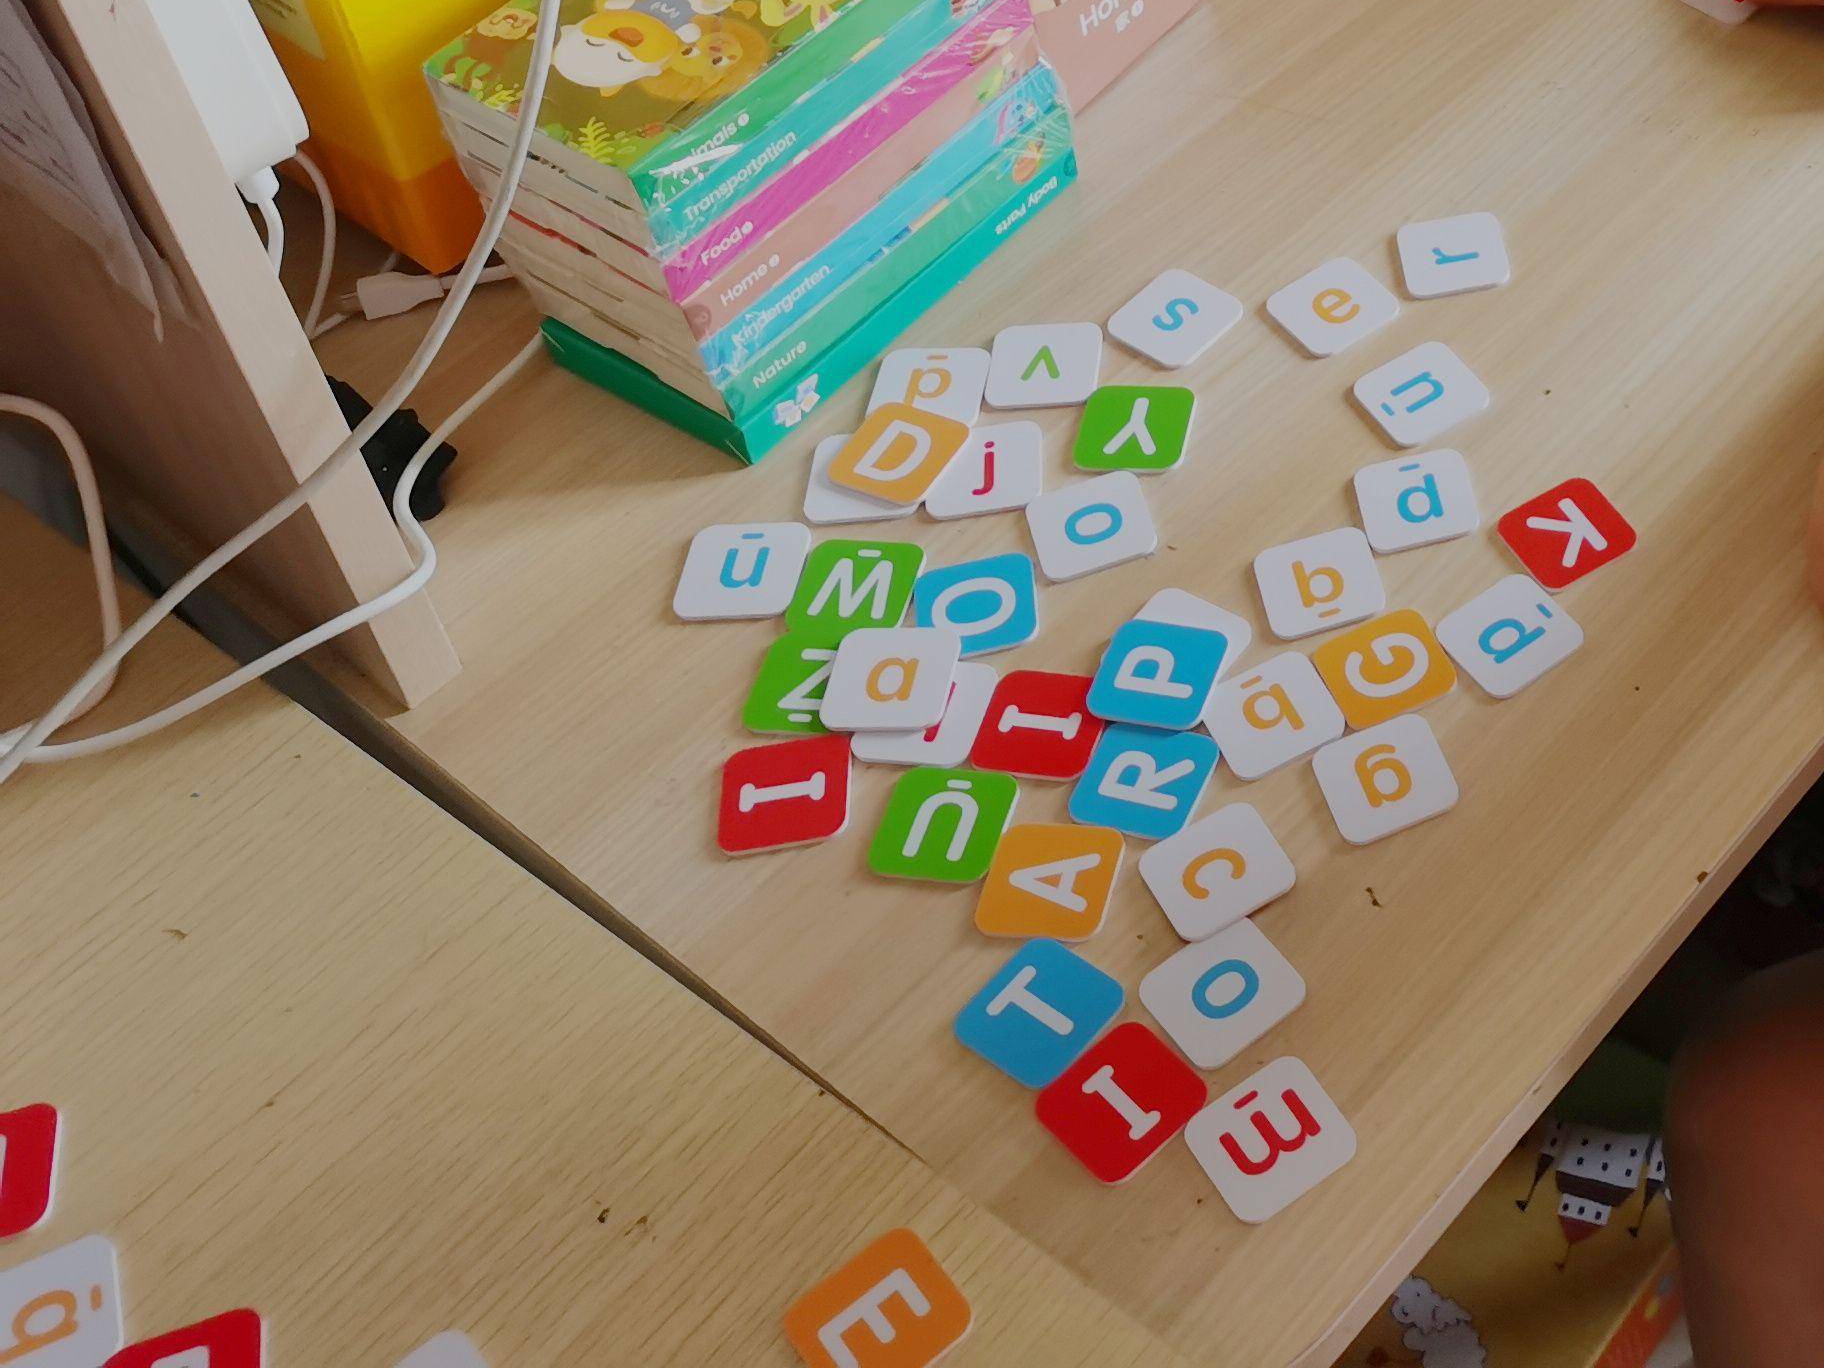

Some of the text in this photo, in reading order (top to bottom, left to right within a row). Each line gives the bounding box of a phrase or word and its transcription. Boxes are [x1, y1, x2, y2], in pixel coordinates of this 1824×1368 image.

[683, 131, 797, 221] Transportation
[994, 175, 1058, 235] Body Parts
[701, 225, 745, 266] Food
[720, 262, 769, 307] Home
[731, 263, 831, 345] Kindergarten
[1312, 290, 1360, 324] e
[1152, 298, 1199, 331] s
[752, 339, 807, 389] Nature
[852, 419, 933, 482] D
[1102, 397, 1157, 455] Y
[971, 440, 996, 497] j
[1526, 498, 1608, 568] K
[866, 656, 919, 703] a
[1114, 645, 1193, 699] P
[1344, 632, 1429, 698] G
[998, 705, 1083, 740] I
[739, 770, 826, 812] I
[1098, 750, 1196, 811] R
[1008, 853, 1101, 913] A
[987, 966, 1074, 1036] T
[1082, 1065, 1161, 1140] I
